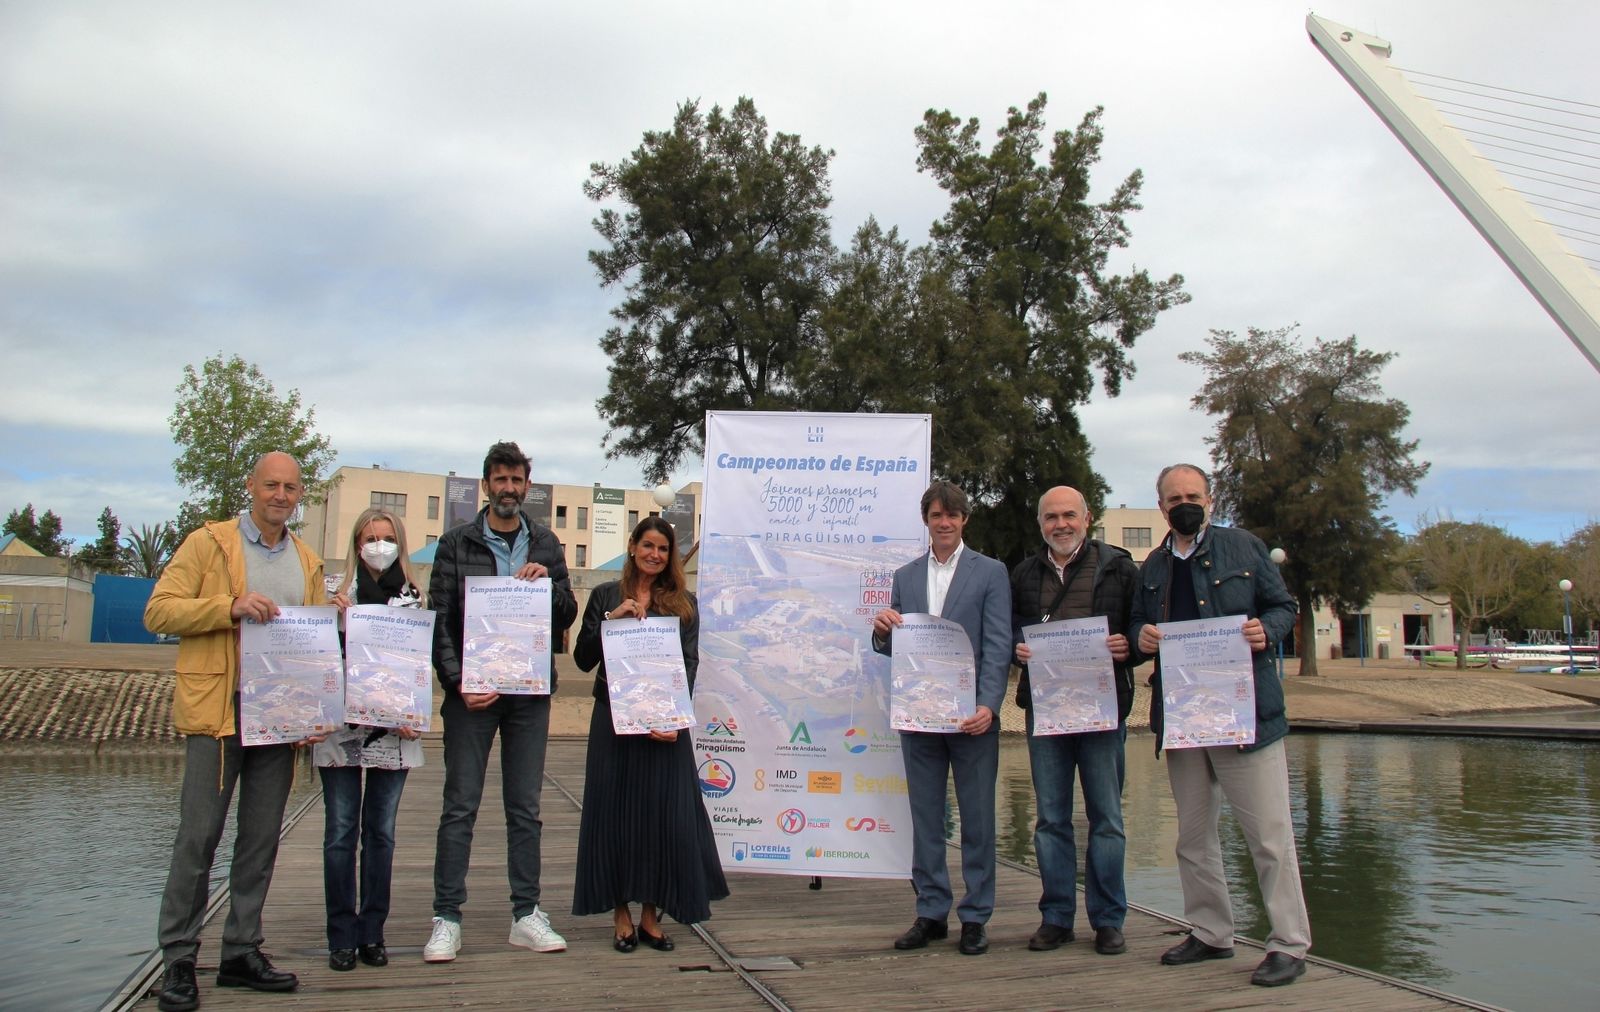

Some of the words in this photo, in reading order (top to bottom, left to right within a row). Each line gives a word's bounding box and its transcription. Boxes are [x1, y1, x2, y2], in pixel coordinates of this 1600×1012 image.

[716, 452, 826, 474] Campeonato
[829, 454, 851, 472] de
[855, 455, 918, 477] España
[760, 476, 813, 503] Jóvenes
[816, 484, 878, 500] promesas
[767, 496, 803, 513] 5000
[807, 503, 817, 521] y
[820, 496, 855, 513] 3000
[859, 505, 874, 514] m
[822, 513, 860, 530] infantil
[765, 532, 866, 543] PIRAGÜISMO
[470, 586, 513, 594] Campeonato
[523, 586, 548, 594] España
[307, 616, 333, 626] España
[351, 612, 395, 623] Campeonato
[406, 618, 431, 628] España
[606, 626, 647, 637] Campeonato
[655, 626, 676, 634] España
[1028, 629, 1070, 640] Campeonato
[1080, 627, 1105, 636] España
[1163, 631, 1208, 642] Campeonato
[1208, 629, 1218, 637] de
[1219, 627, 1242, 636] Españ
[696, 743, 746, 753] Piragüismo
[776, 769, 798, 780] IMD
[706, 791, 724, 799] RFEP
[751, 845, 792, 853] LOTERÍAS
[823, 850, 870, 859] IBERDROLA
